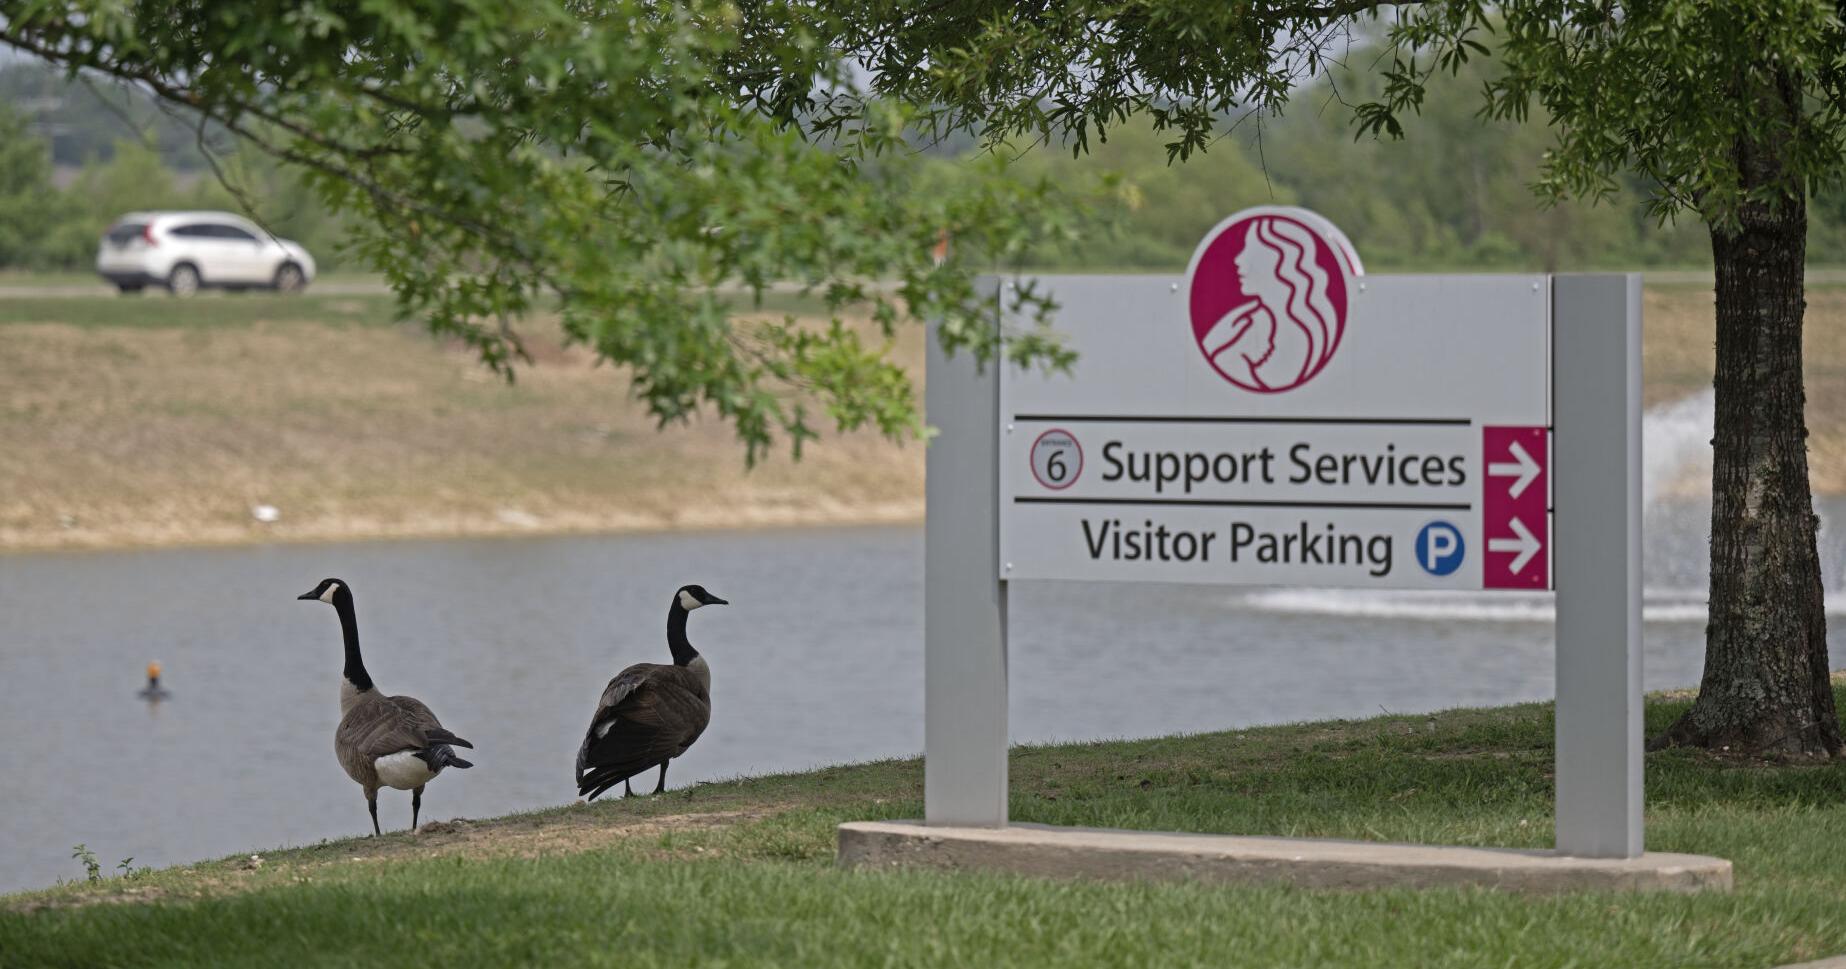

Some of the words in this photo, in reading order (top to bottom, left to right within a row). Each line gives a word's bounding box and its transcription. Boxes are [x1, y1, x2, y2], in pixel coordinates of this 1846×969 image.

[1046, 450, 1067, 482] 6
[1101, 440, 1275, 494] Support
[1288, 442, 1467, 487] Services
[1080, 519, 1217, 562] Visitor
[1230, 520, 1393, 578] Parking
[1428, 528, 1457, 570] P
